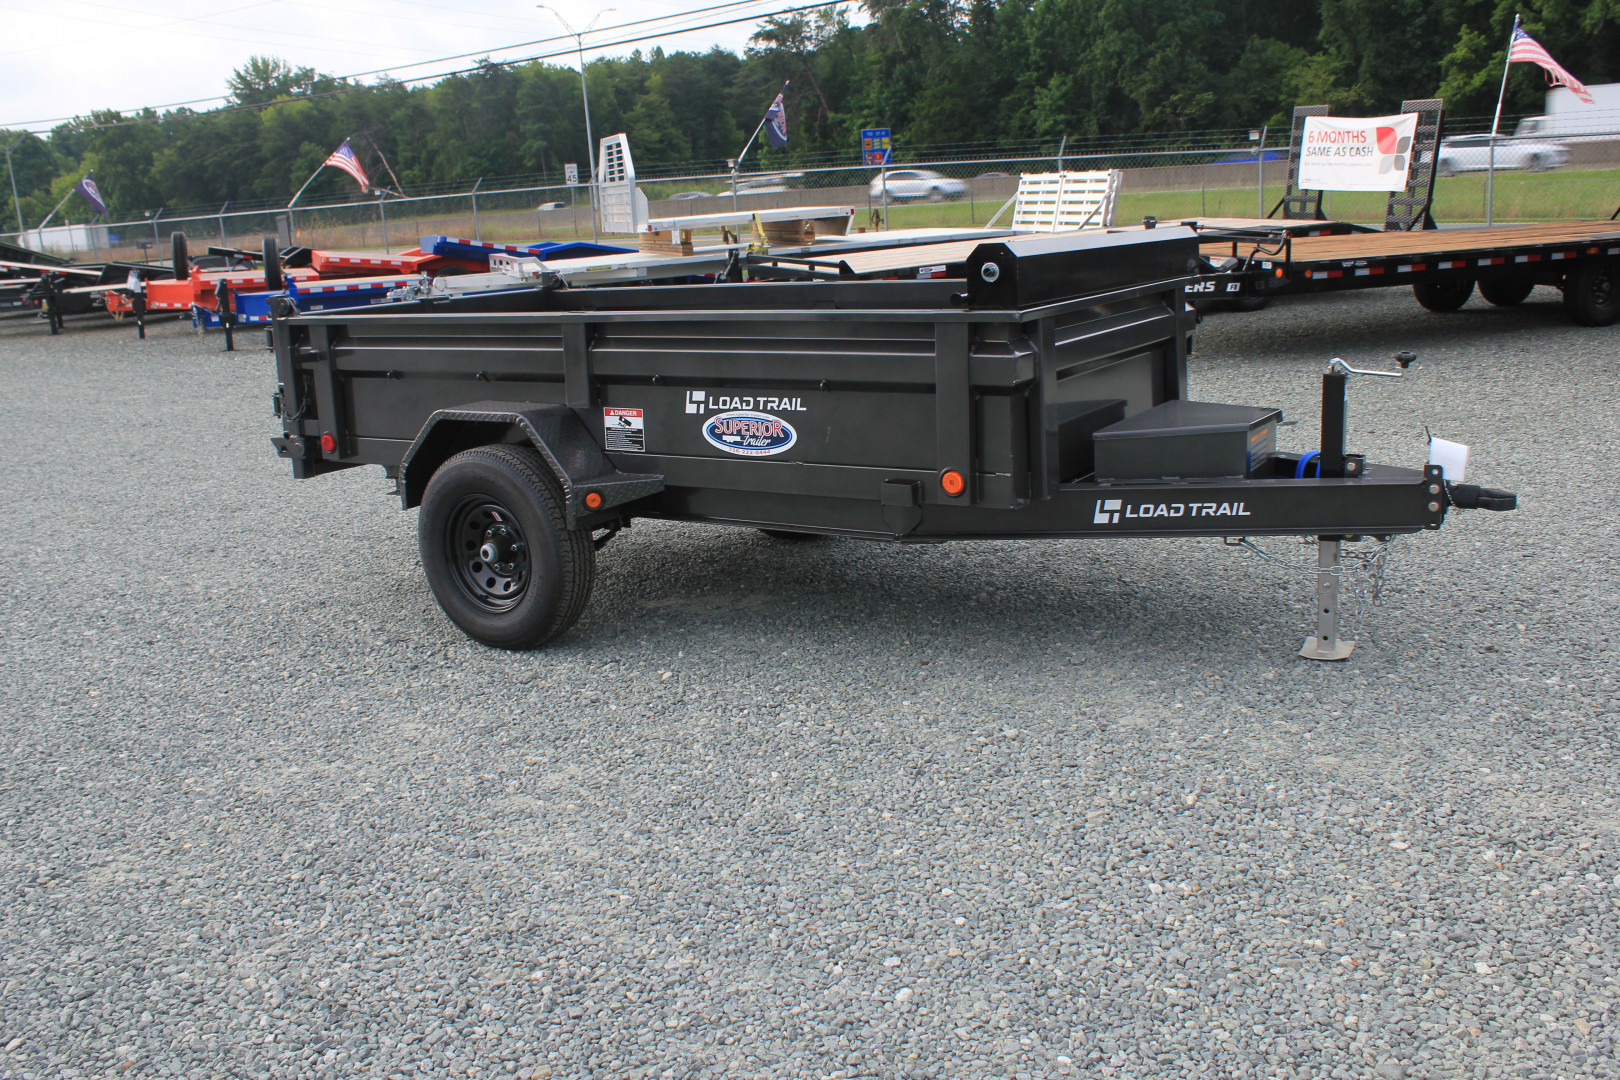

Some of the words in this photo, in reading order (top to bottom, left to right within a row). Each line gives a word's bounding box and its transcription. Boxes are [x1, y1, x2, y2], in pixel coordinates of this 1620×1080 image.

[1308, 131, 1315, 144] 6
[1316, 130, 1367, 144] MONTHS
[1305, 146, 1332, 157] SAME
[1333, 146, 1347, 157] AS
[1349, 146, 1374, 157] CASH
[567, 174, 577, 182] 45
[708, 397, 754, 410] LOAD
[756, 397, 807, 412] TRAIL
[714, 417, 784, 438] SUPERIOR
[1125, 503, 1185, 518] LOAD
[1188, 502, 1252, 517] TRAIL
